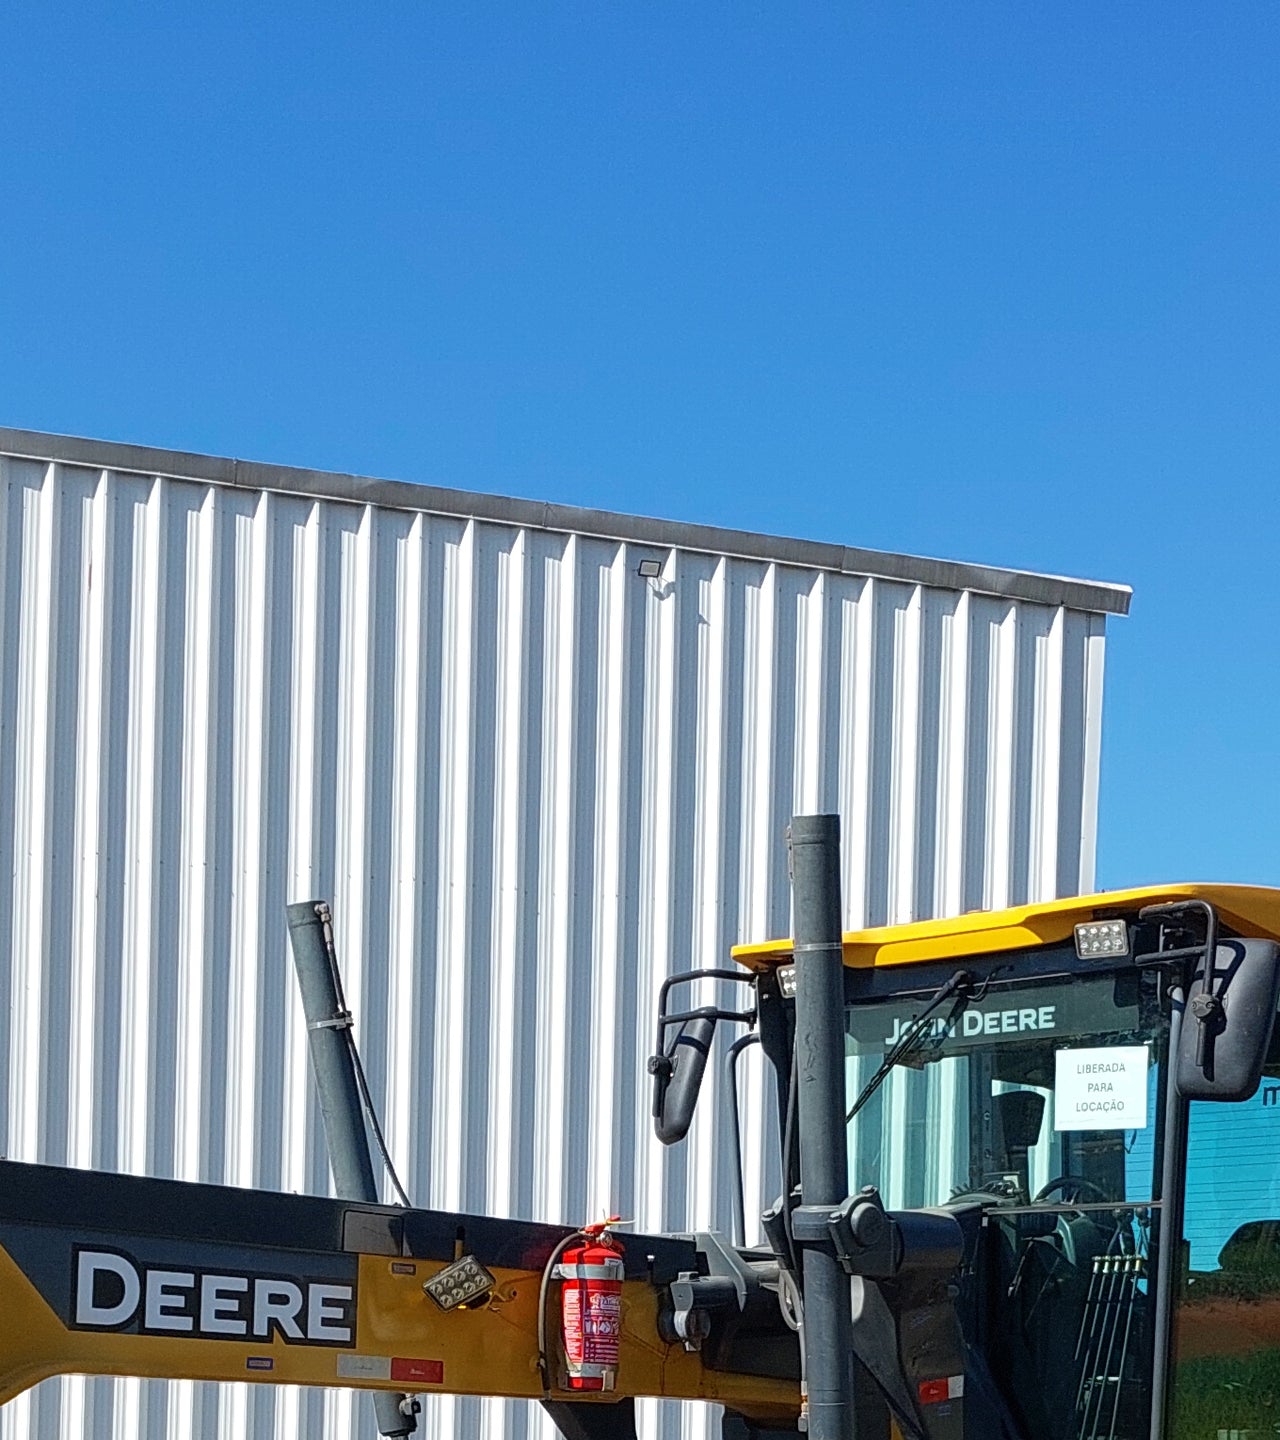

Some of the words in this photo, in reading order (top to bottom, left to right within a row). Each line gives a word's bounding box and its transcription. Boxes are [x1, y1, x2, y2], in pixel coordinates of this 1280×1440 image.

[963, 1006, 1056, 1037] DEERE
[1076, 1063, 1126, 1075] LIBERADA
[1087, 1082, 1114, 1093] PARA
[1076, 1099, 1125, 1113] LOCAÇÃO
[76, 1250, 353, 1342] DEERE
